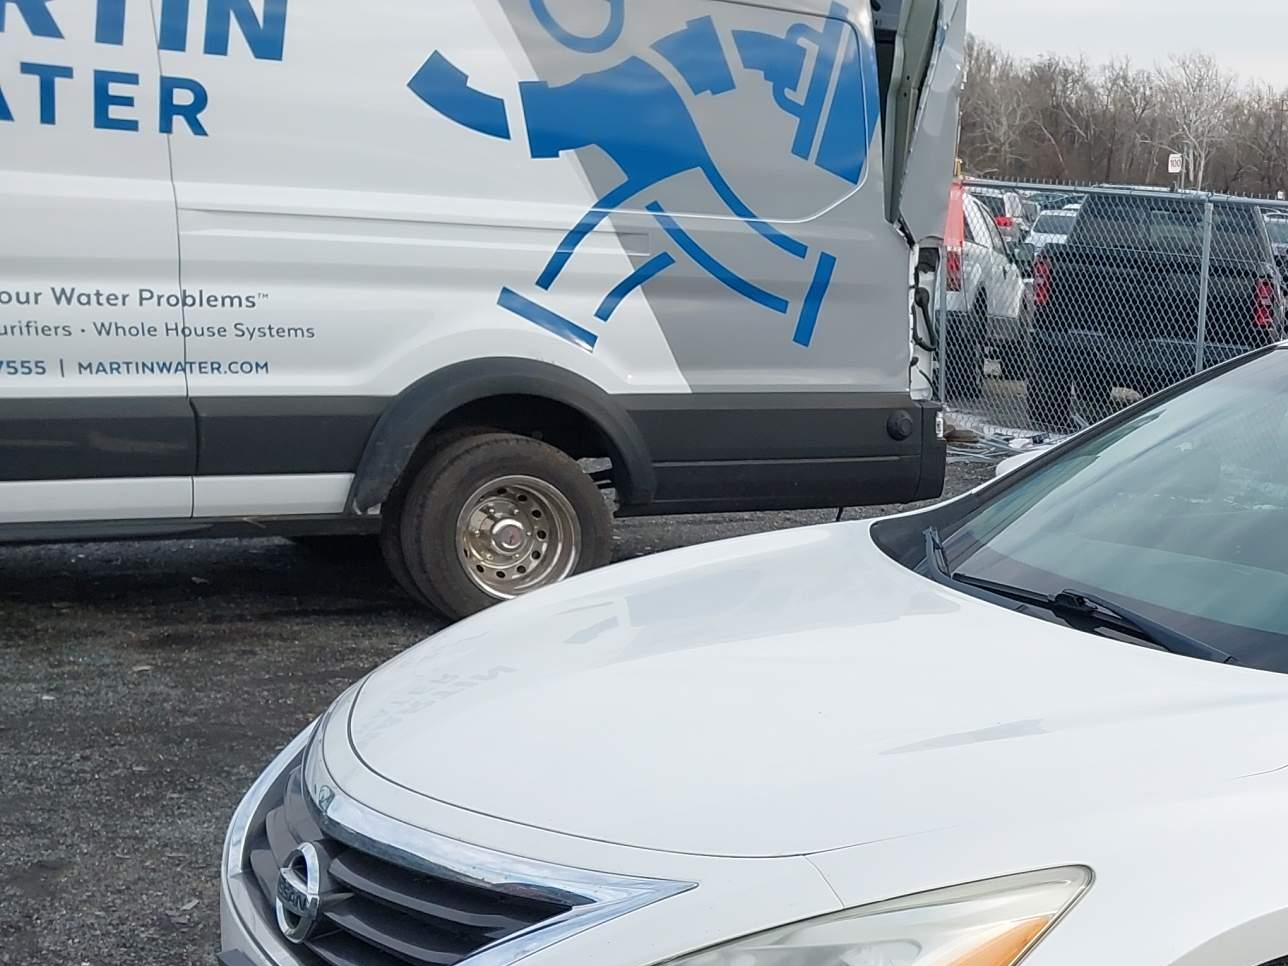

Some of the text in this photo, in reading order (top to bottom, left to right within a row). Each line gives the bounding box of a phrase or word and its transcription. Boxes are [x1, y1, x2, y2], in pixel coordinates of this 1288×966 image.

[50, 286, 130, 306] Water
[93, 321, 158, 337] Whole
[165, 322, 227, 338] House
[233, 322, 316, 341] Systems
[78, 361, 269, 375] MARTINWATER.COM
